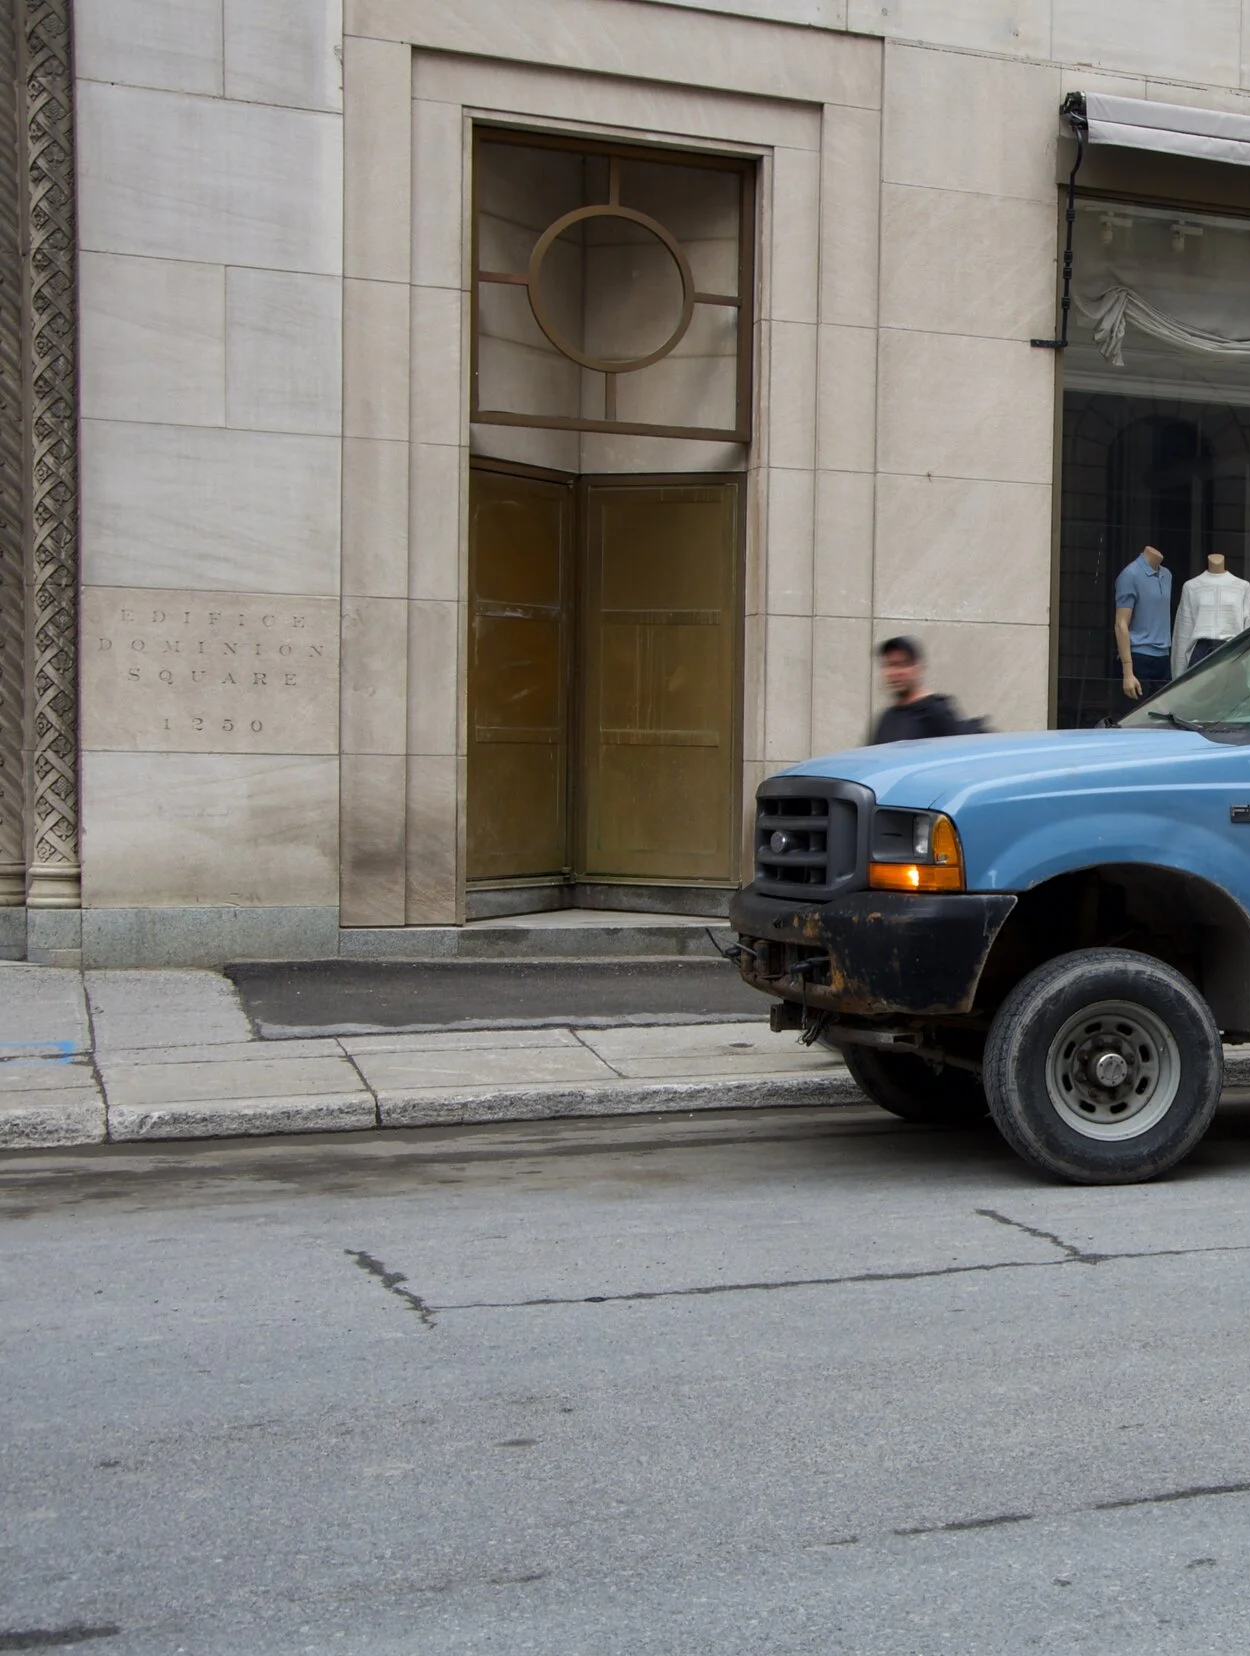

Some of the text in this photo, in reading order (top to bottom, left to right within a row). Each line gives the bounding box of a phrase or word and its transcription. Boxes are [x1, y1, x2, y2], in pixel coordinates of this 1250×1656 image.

[121, 609, 305, 629] EDIFICE
[98, 637, 324, 658] DOMINION
[127, 668, 297, 686] SQUARE
[163, 717, 263, 733] 1250
